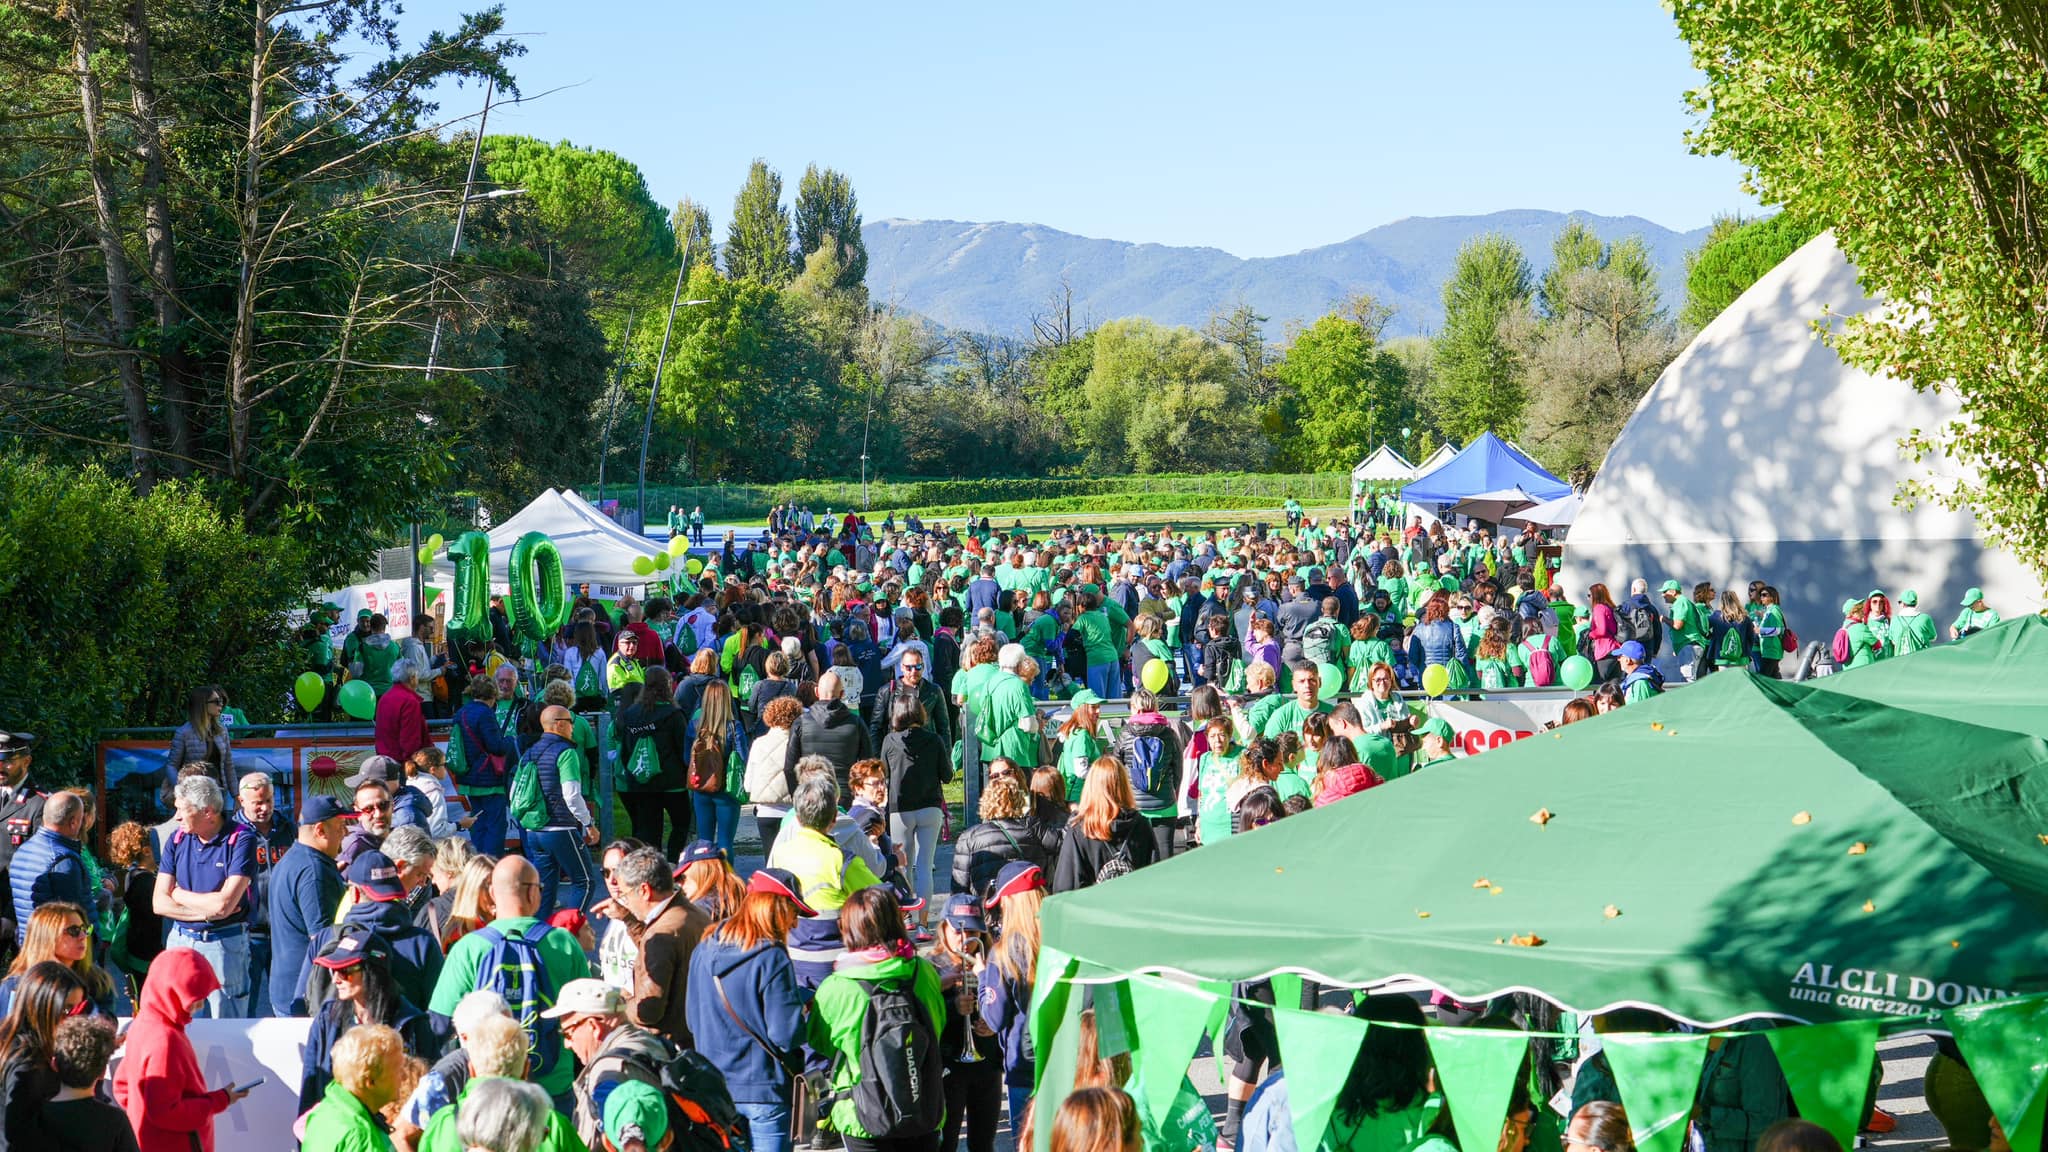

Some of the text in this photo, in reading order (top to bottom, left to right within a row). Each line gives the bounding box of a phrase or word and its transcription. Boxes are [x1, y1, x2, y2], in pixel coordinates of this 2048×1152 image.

[600, 585, 618, 596] RITIRA
[1791, 962, 1898, 997] ALCLI
[1789, 986, 1832, 1003] una
[1836, 993, 1922, 1016] carezza
[906, 1047, 920, 1103] DIADORA
